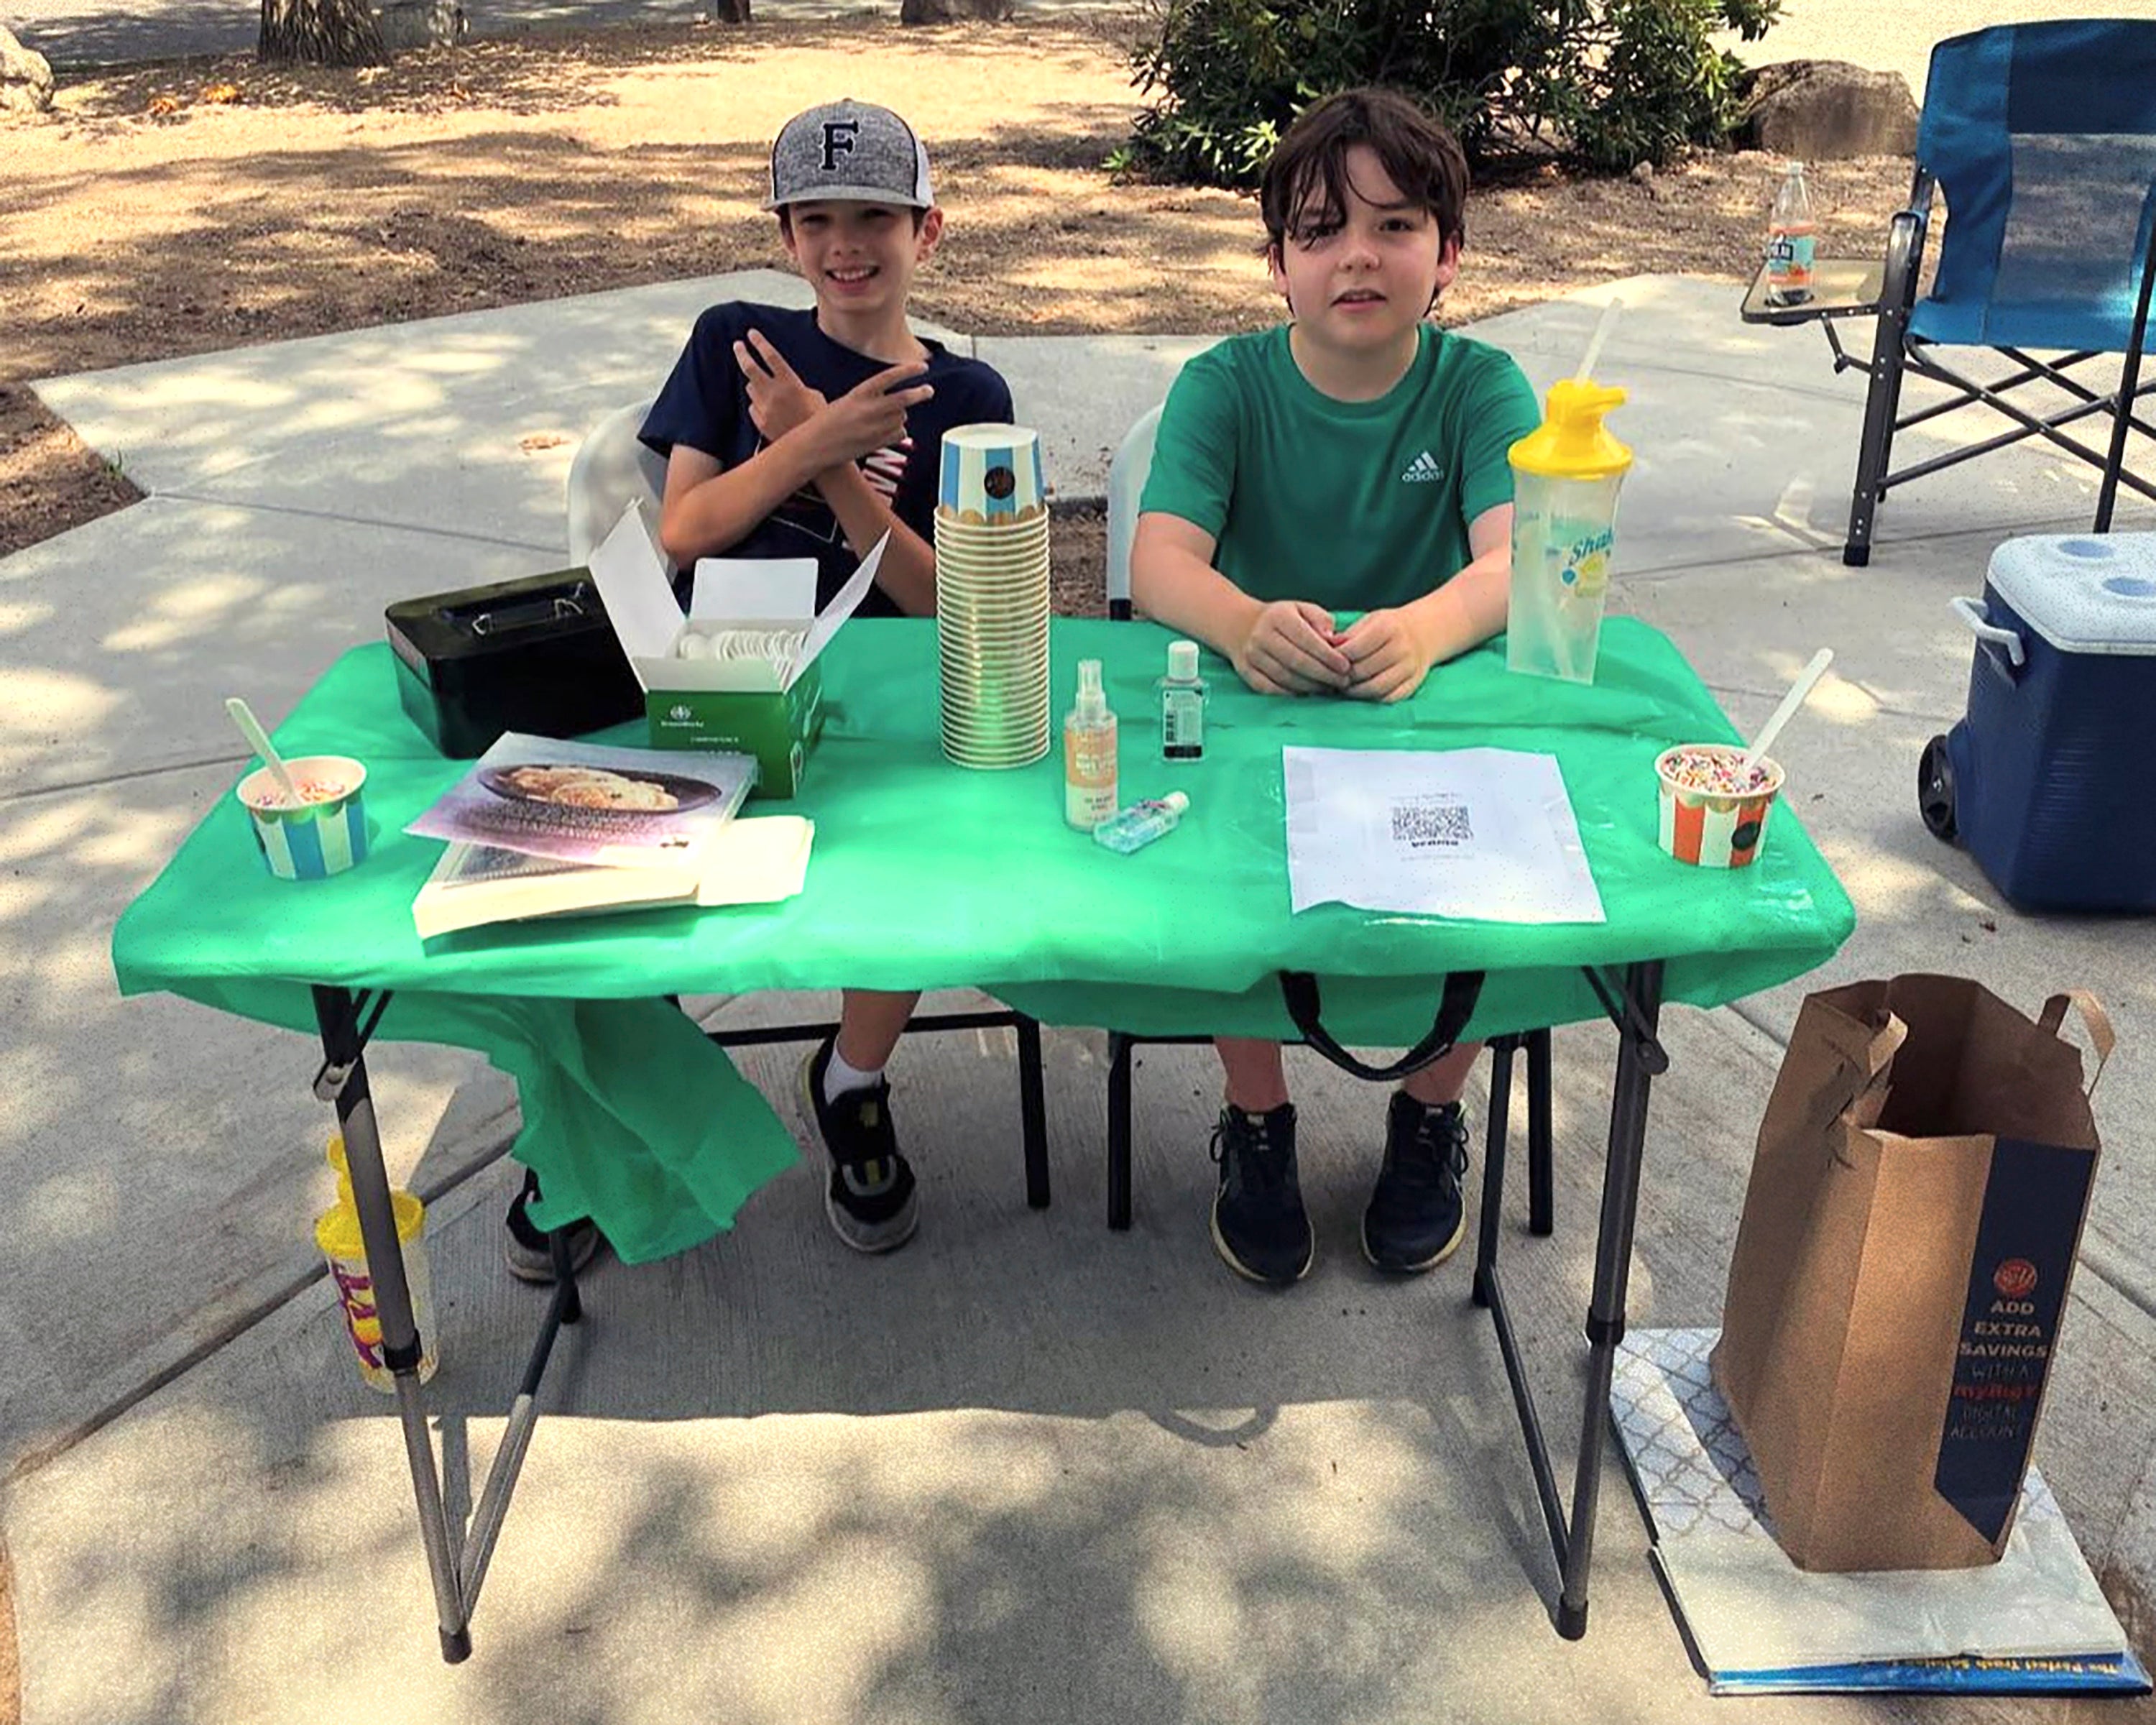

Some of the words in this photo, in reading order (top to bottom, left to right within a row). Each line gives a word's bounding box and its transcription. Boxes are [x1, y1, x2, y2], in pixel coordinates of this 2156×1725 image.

[821, 119, 860, 171] F
[1990, 1300, 2035, 1315] ADD
[1973, 1320, 2042, 1338] EXTRA
[1958, 1342, 2048, 1358] SAVINGS
[1975, 1658, 2021, 1671] Trash
[2026, 1660, 2083, 1674] Perfect
[2088, 1663, 2119, 1675] The
